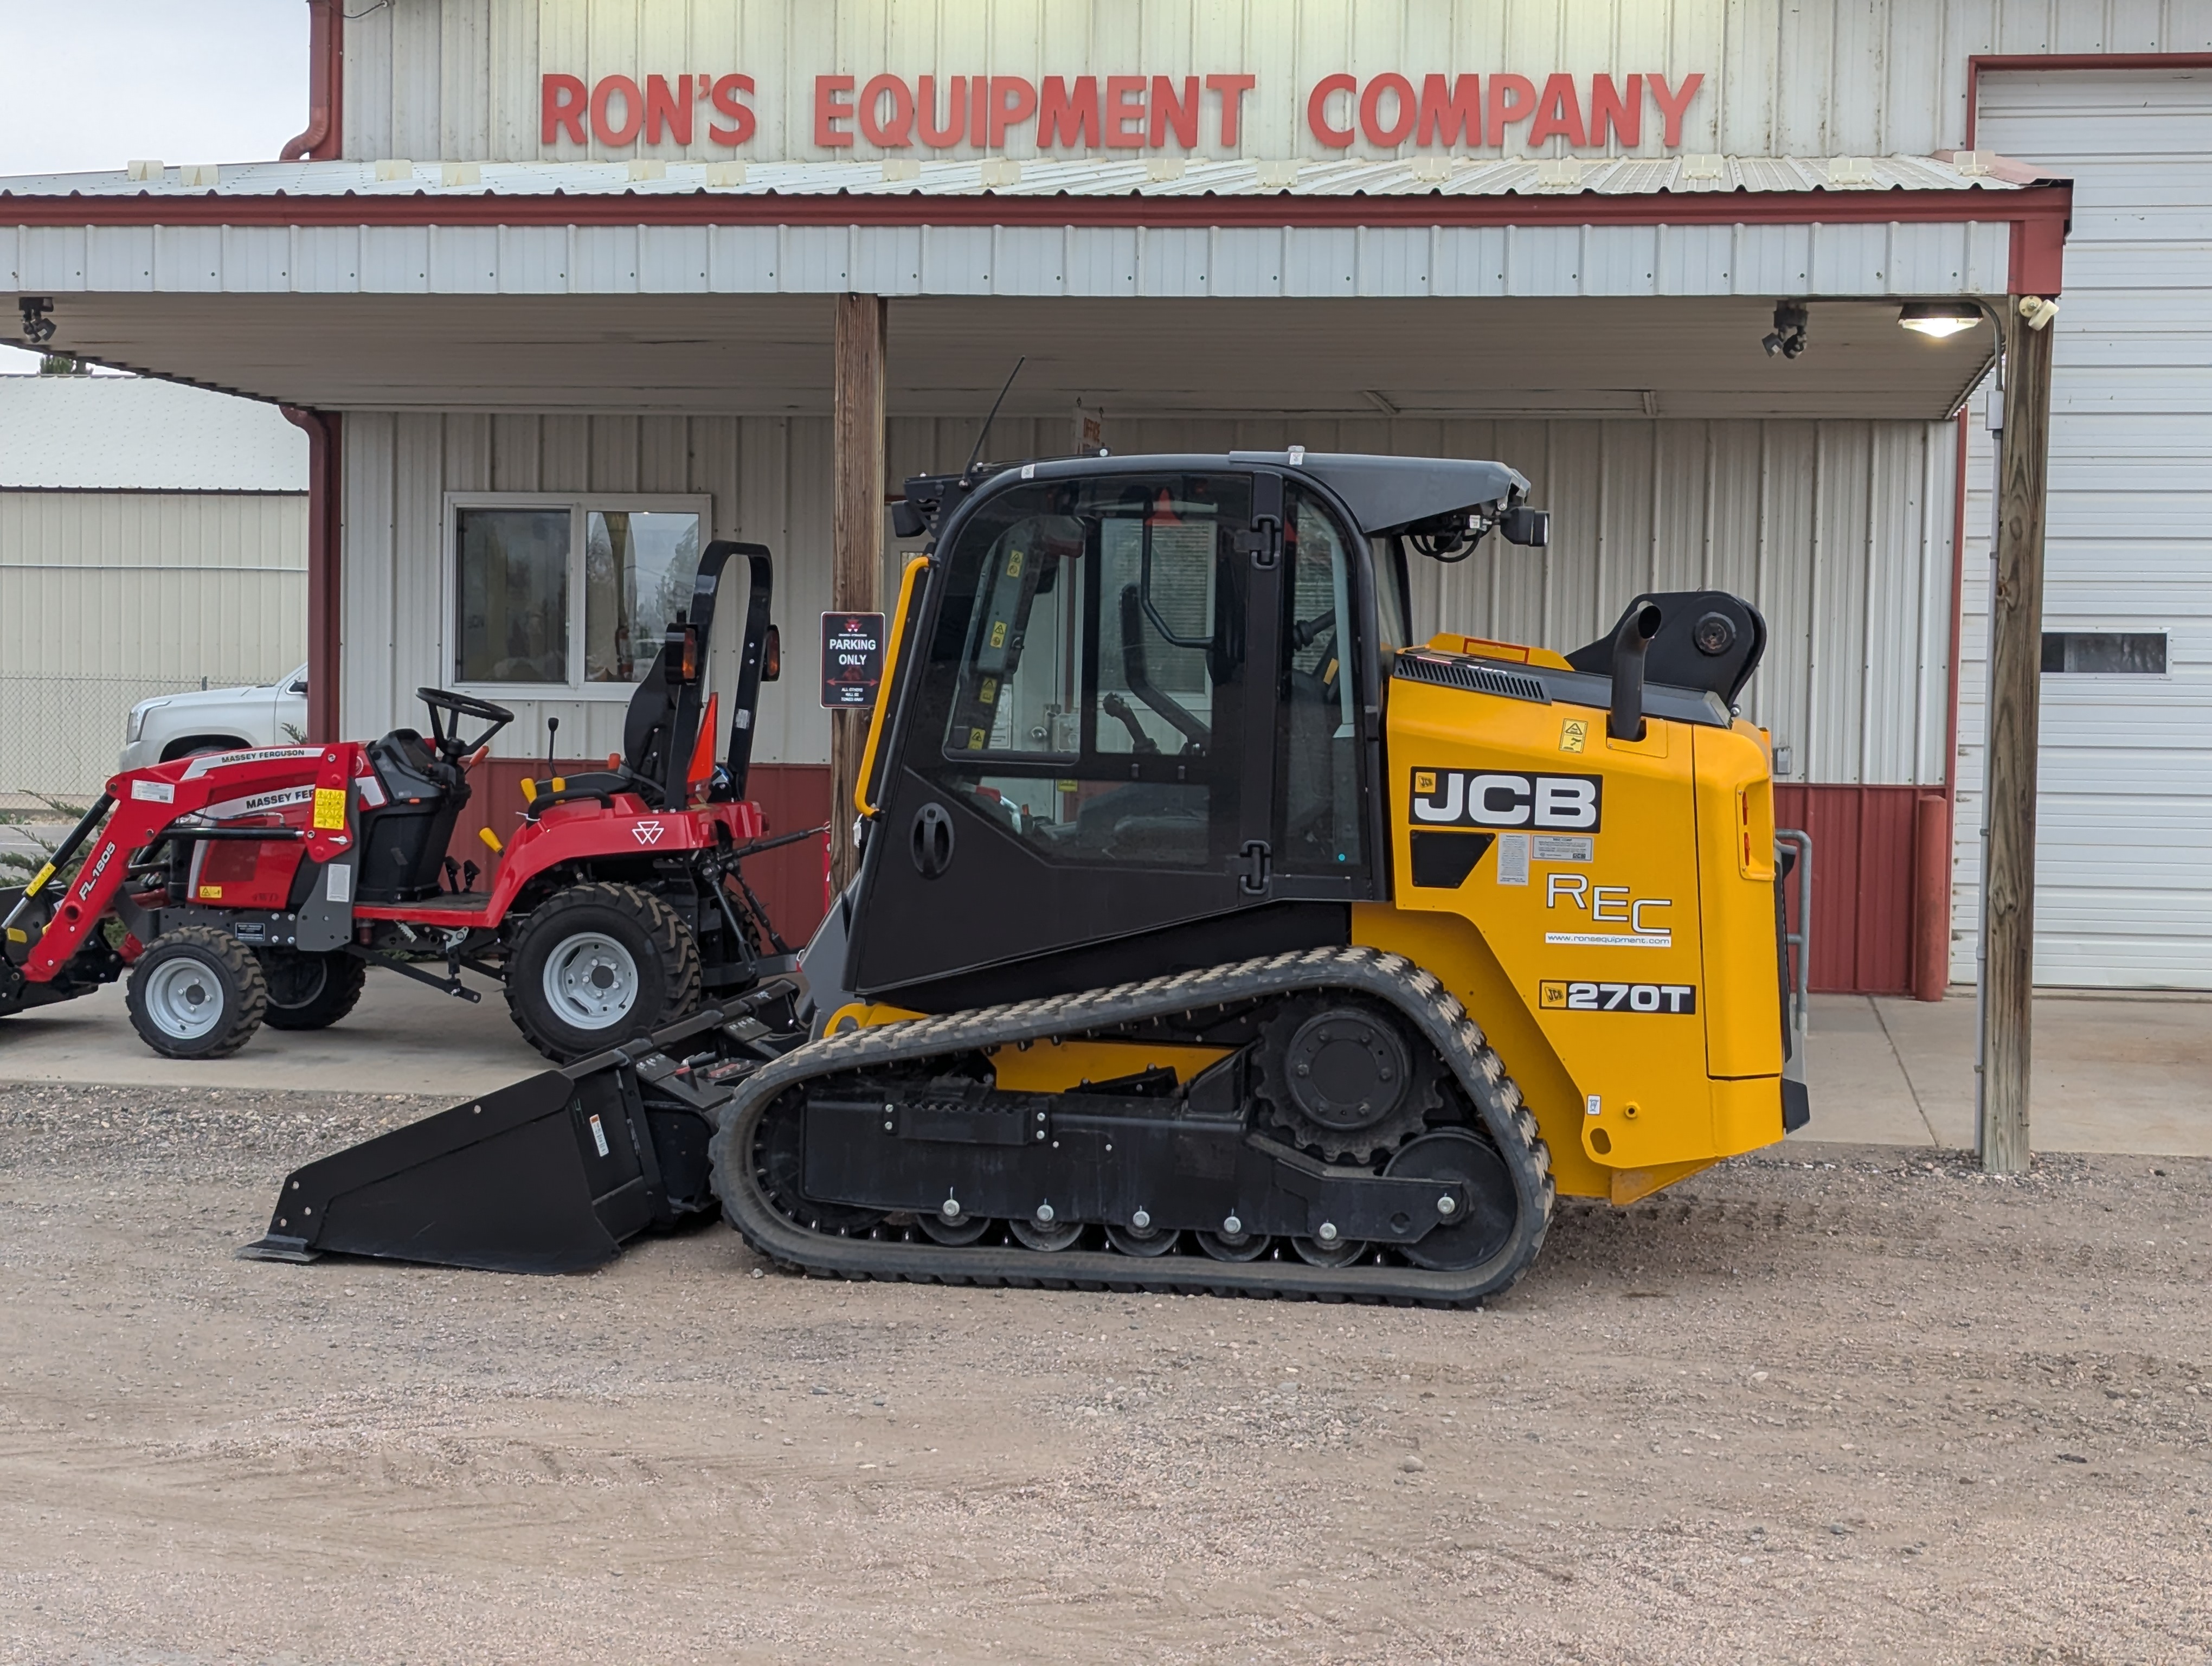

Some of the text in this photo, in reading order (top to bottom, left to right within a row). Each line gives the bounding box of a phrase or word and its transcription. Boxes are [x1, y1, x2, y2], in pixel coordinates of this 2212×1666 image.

[542, 72, 1706, 149] RON'S EQUIPMENT COMPANY
[829, 639, 876, 650] PARKING
[838, 654, 867, 665] ONLY
[222, 749, 305, 762] MASSEY FERGUSON
[246, 792, 292, 809] MASSEY
[1414, 773, 1597, 828] JCB
[1547, 873, 1672, 935] REC
[1548, 983, 1690, 1012] JCB 270T
